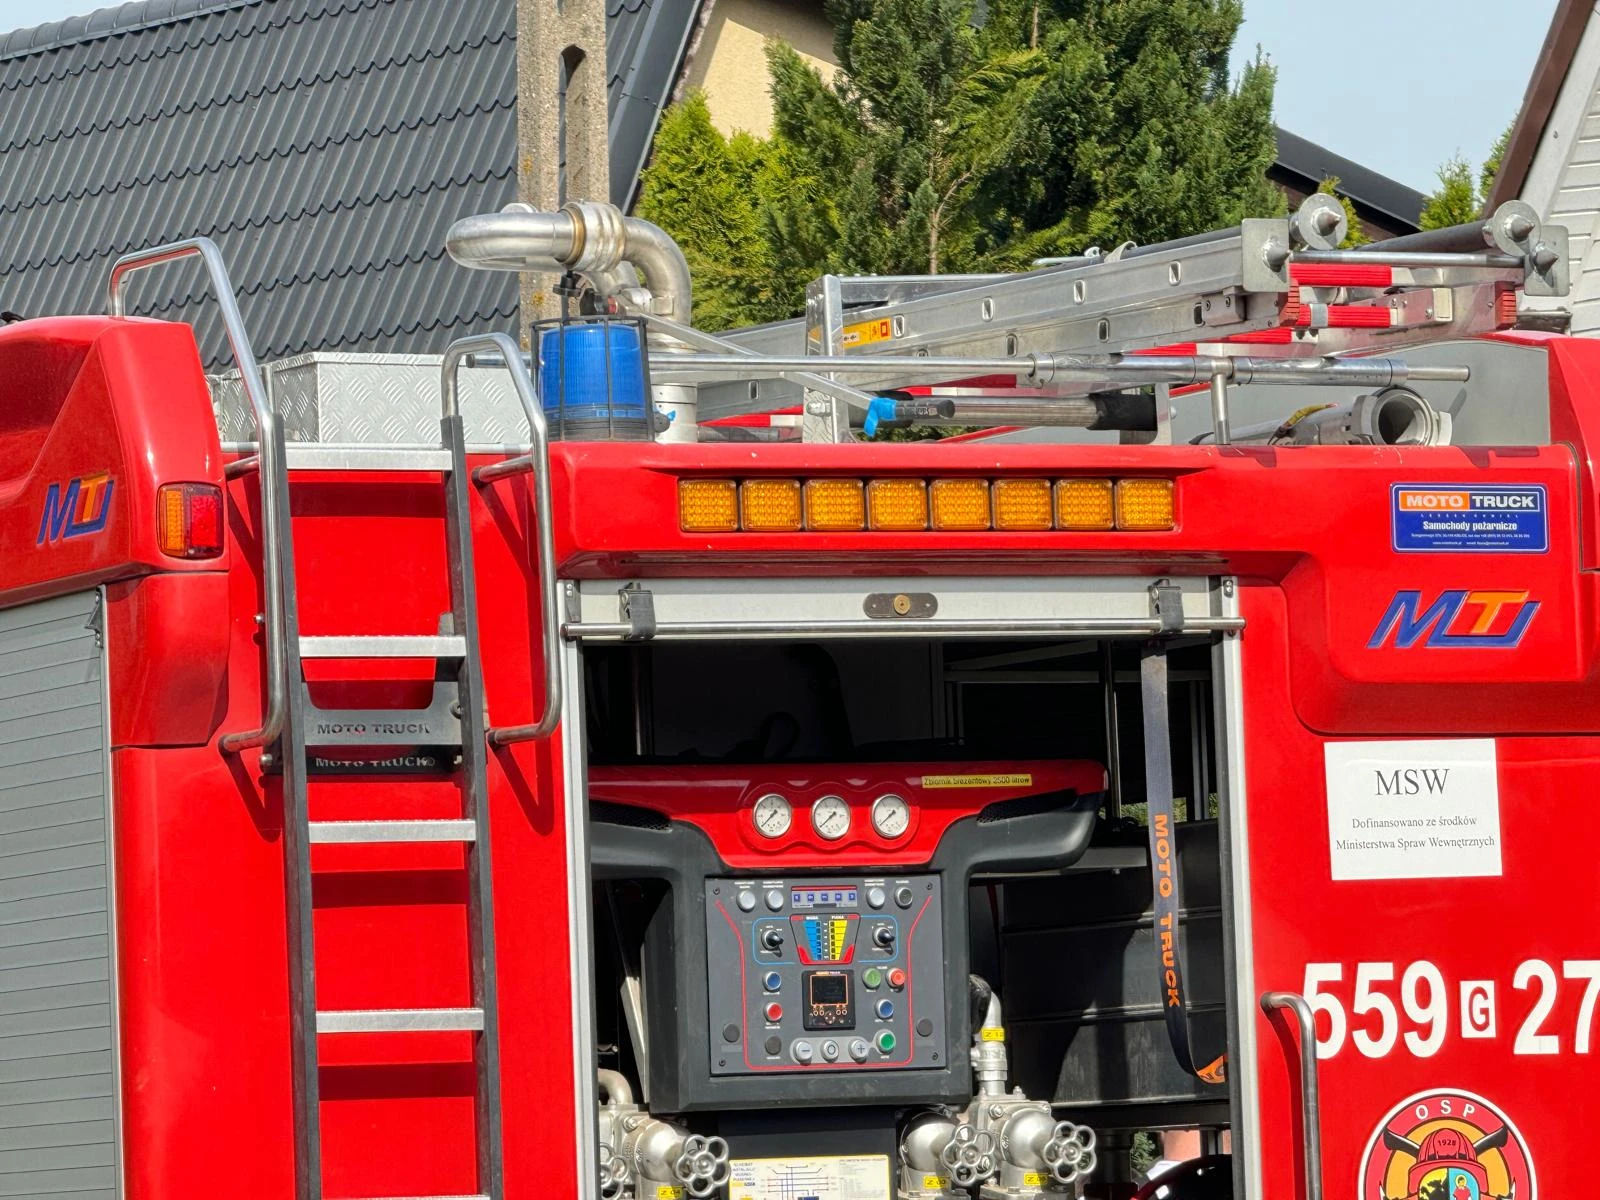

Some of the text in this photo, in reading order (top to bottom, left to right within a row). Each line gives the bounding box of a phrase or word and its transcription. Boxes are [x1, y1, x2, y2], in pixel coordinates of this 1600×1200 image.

[1406, 495, 1535, 508] MOTO TRUCK
[1422, 520, 1518, 532] Samochody pożarnicze
[317, 723, 430, 734] MOTO TRUCK
[993, 775, 1010, 784] 2500
[1374, 768, 1450, 796] MSW
[1352, 815, 1478, 829] Dofinansowano ze środków
[1336, 835, 1495, 851] Ministerstwa Spraw Wewnętrznych
[1154, 814, 1181, 1008] MOTO TRUCK
[1302, 958, 1600, 1060] 559 G 27
[1437, 1139, 1457, 1147] 1928
